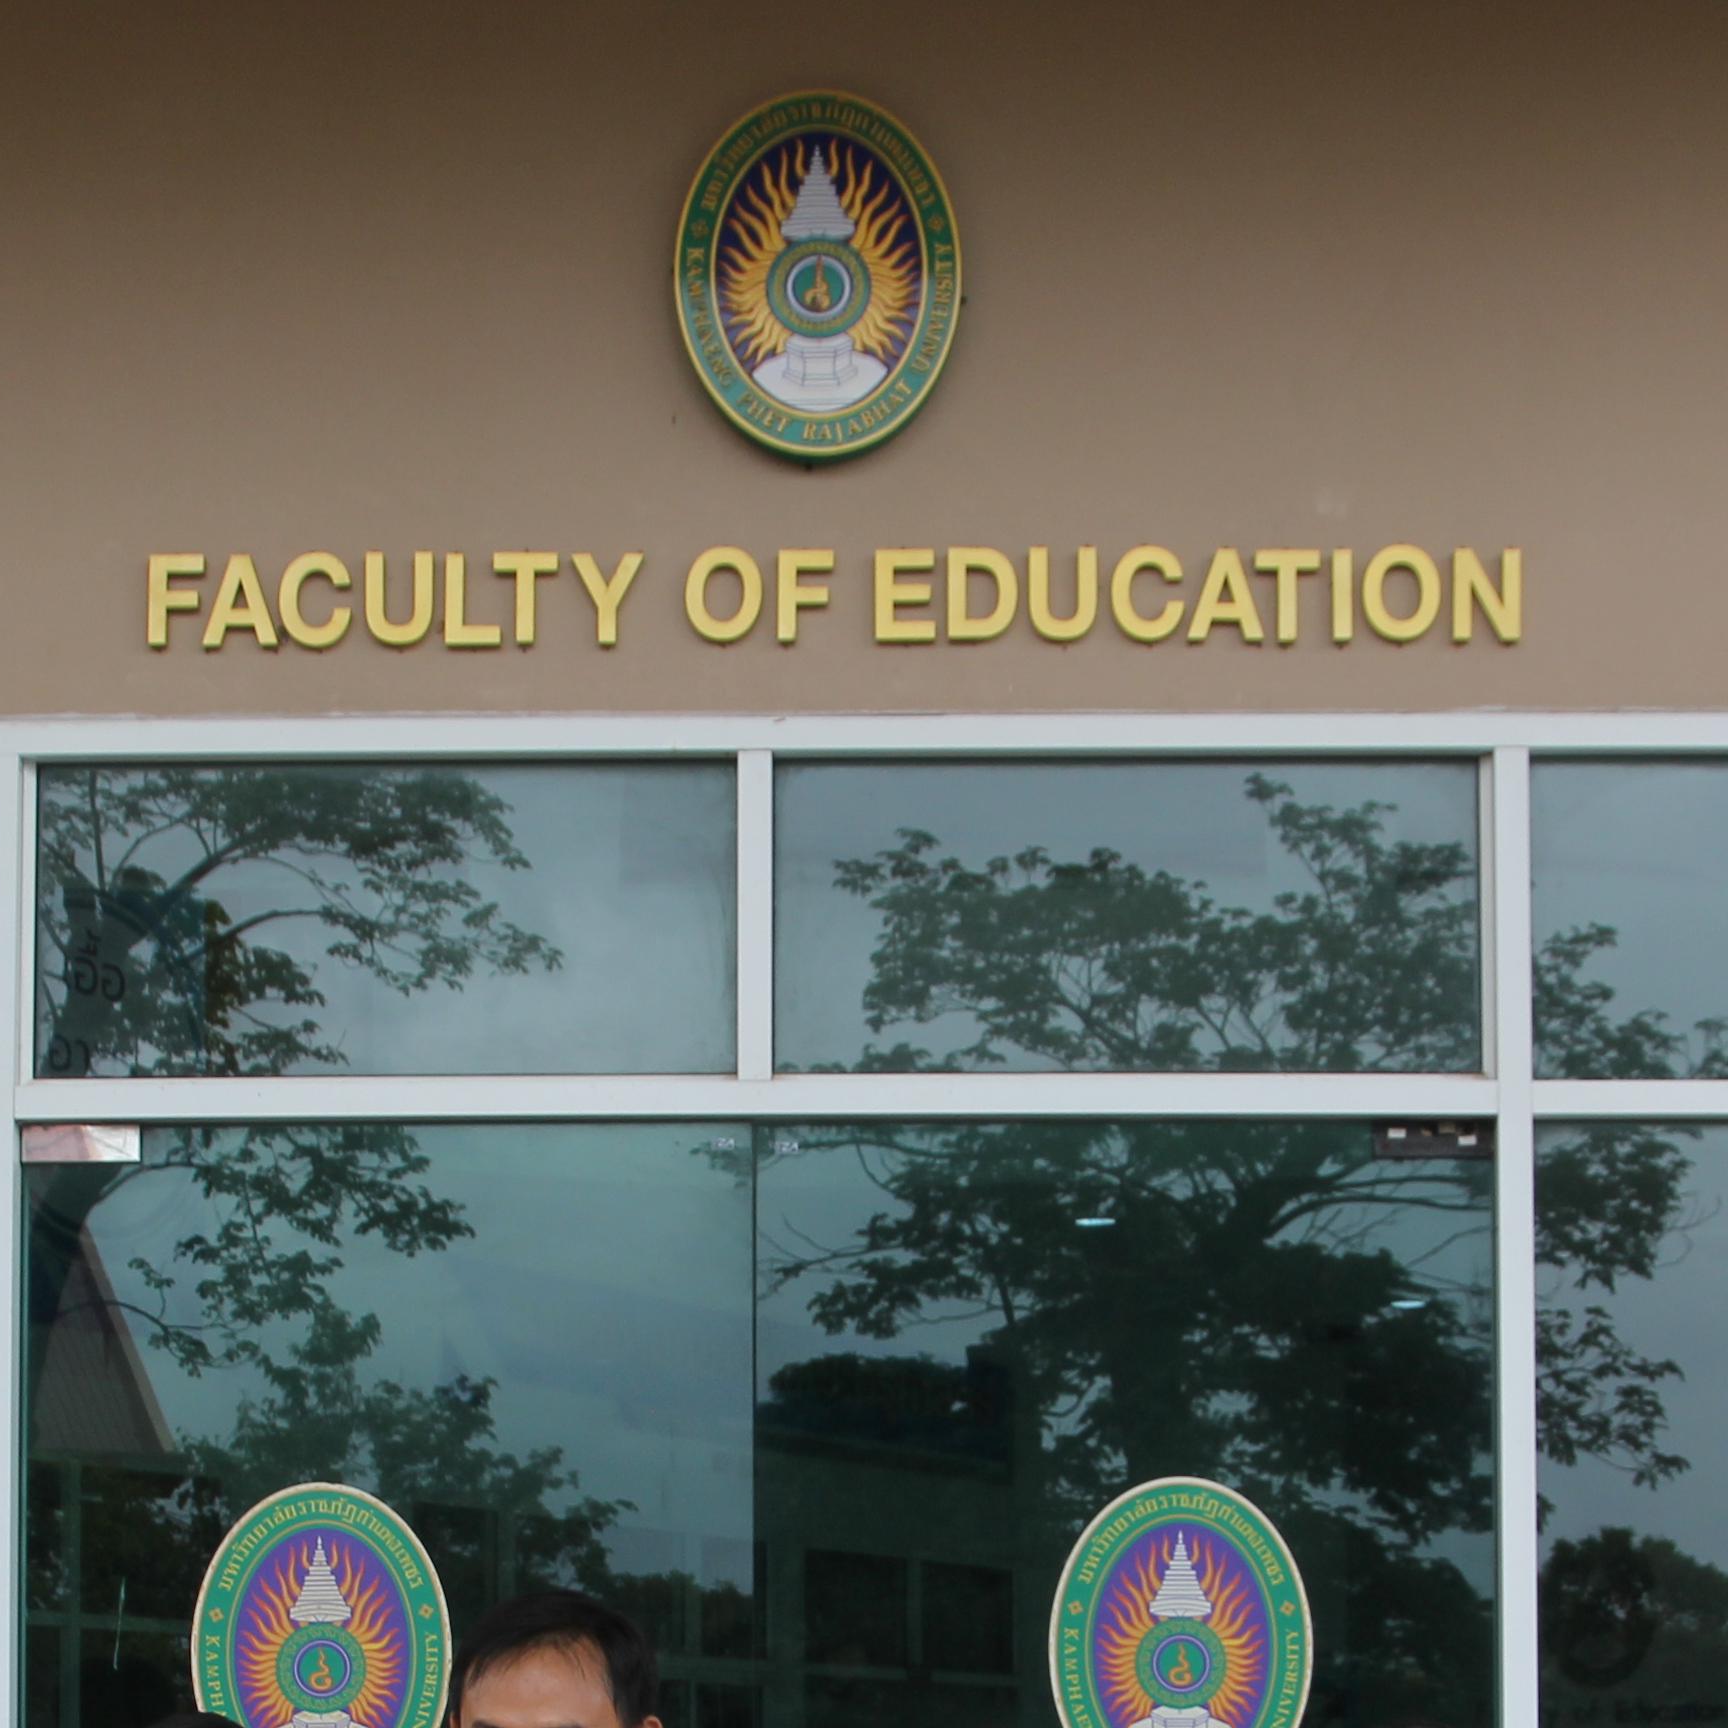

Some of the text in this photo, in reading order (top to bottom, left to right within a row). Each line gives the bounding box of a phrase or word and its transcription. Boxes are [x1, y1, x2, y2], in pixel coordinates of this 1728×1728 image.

[147, 543, 1521, 648] FACULTY OF EDUCATION
